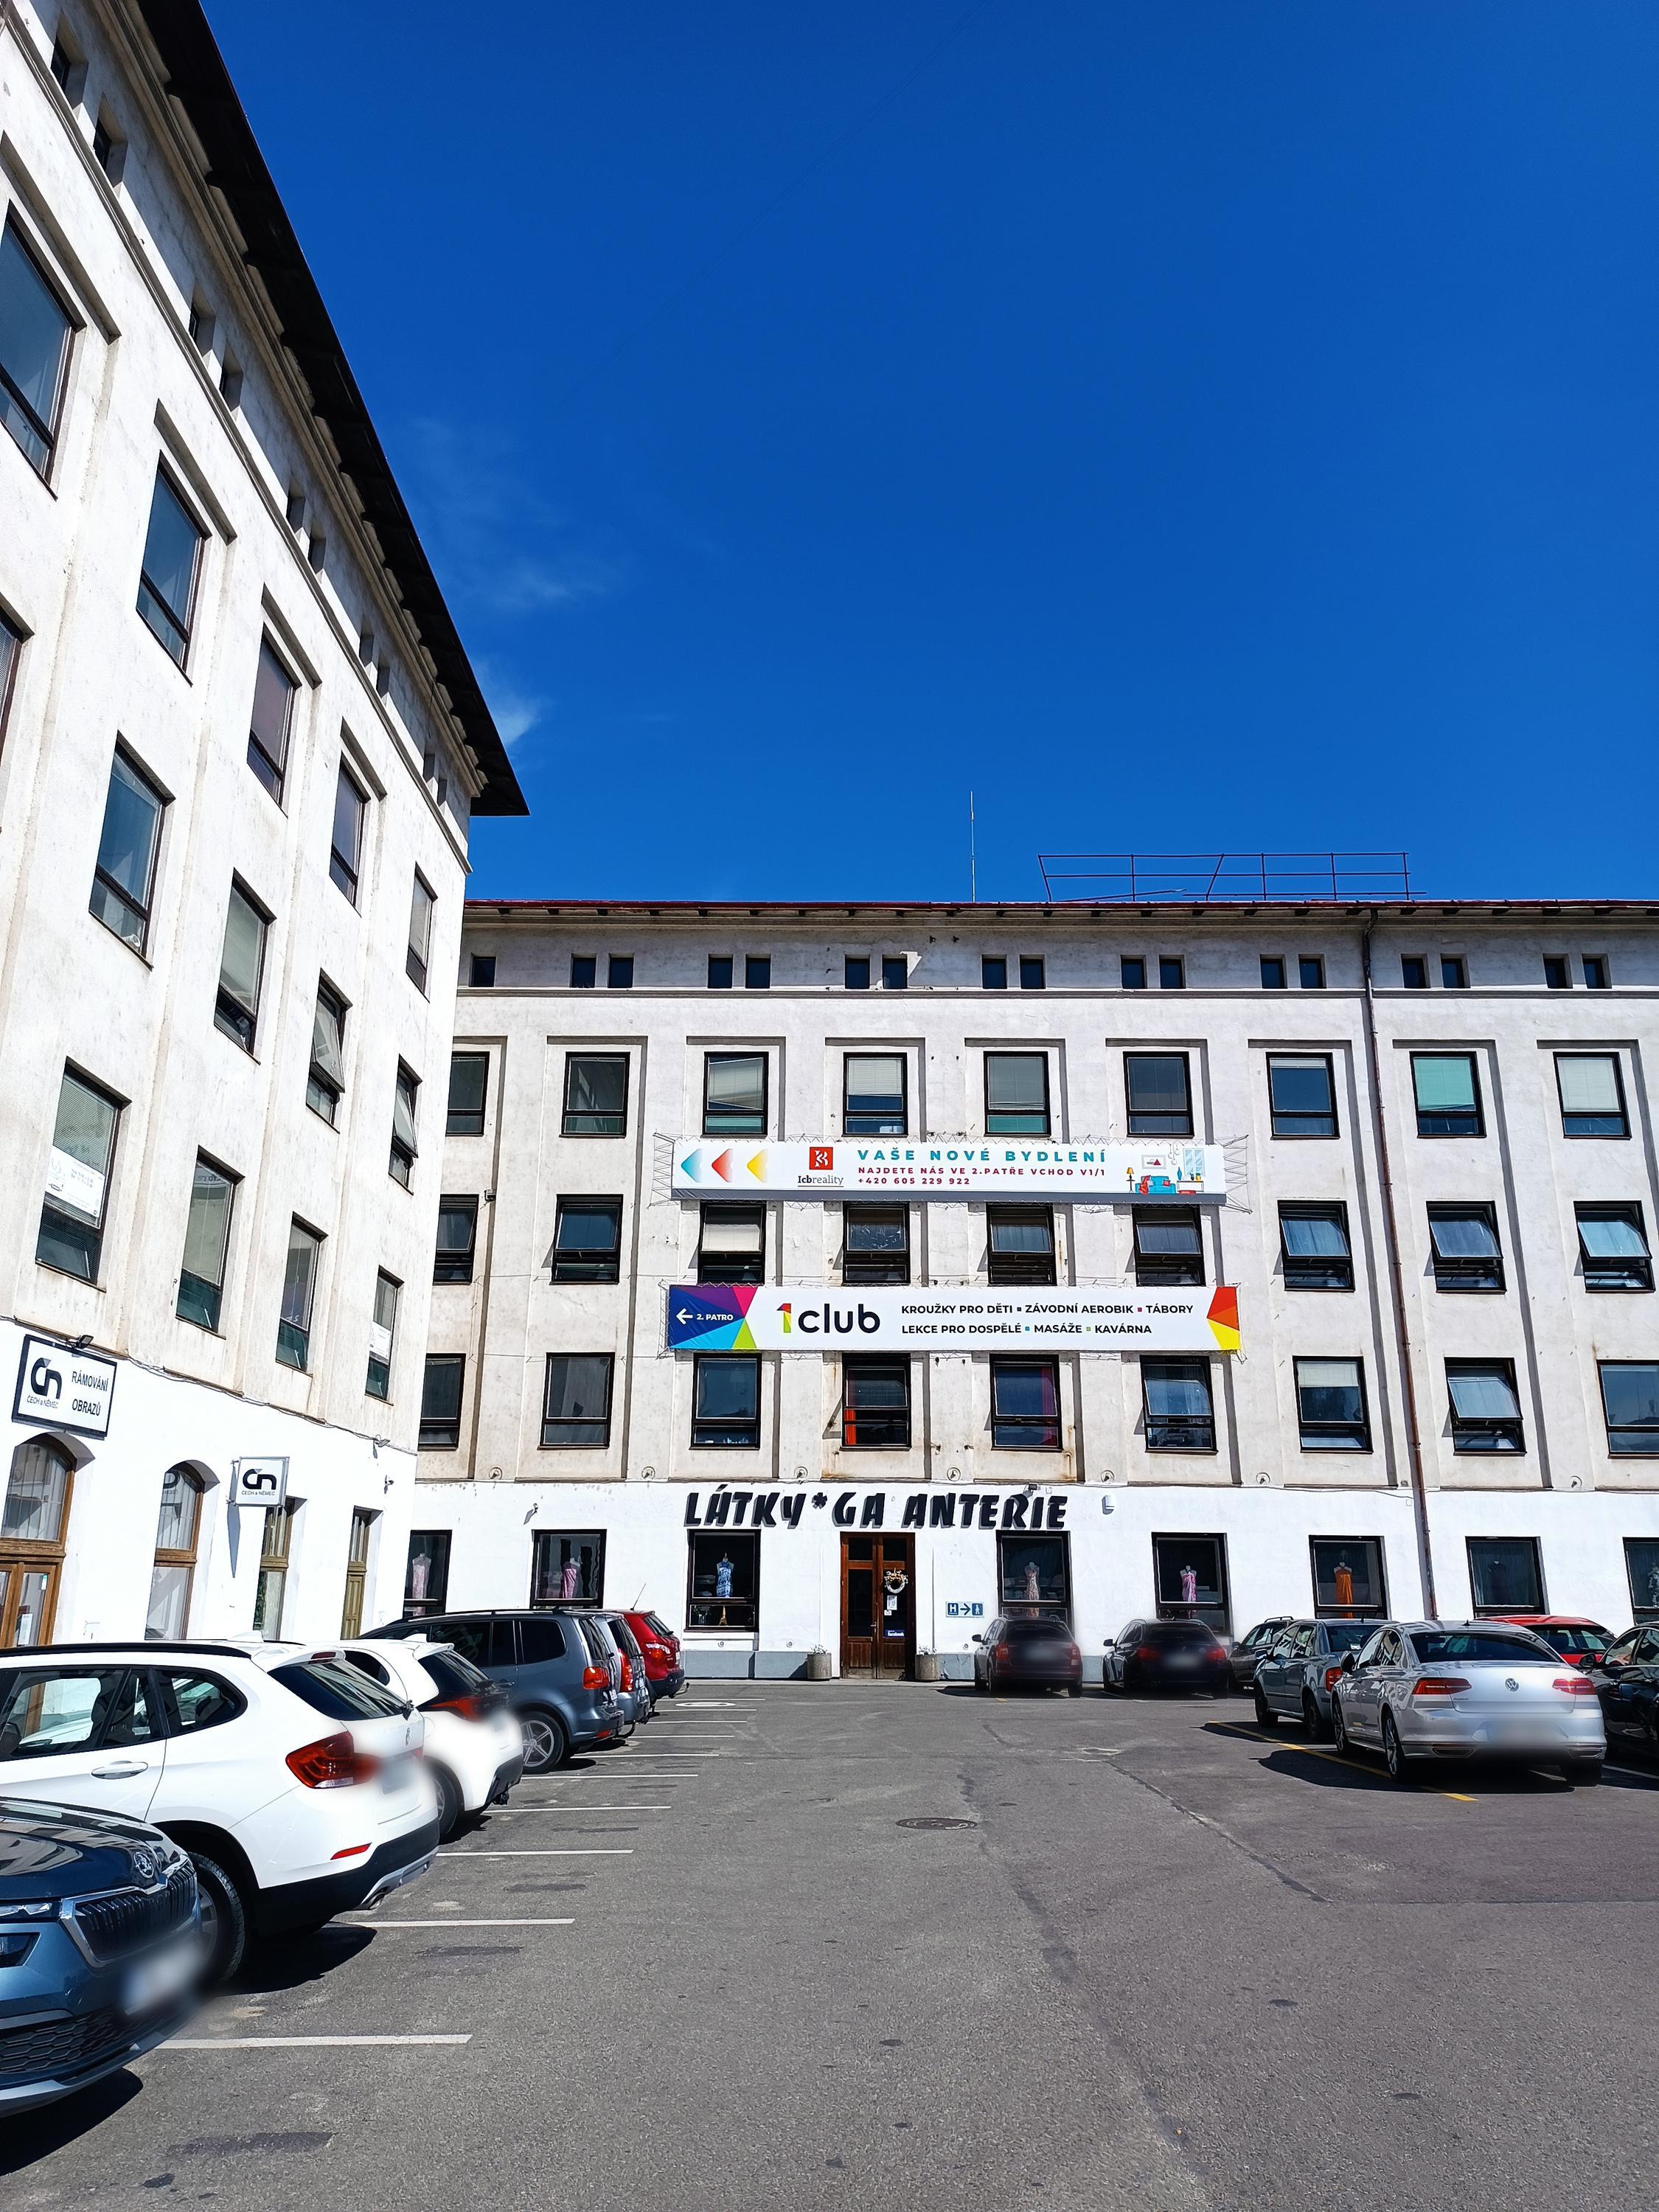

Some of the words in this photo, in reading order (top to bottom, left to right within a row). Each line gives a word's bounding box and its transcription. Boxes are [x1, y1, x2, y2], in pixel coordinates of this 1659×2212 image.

[858, 1147, 915, 1161] VAŠE
[930, 1148, 990, 1161] NOVÉ
[1005, 1149, 1105, 1163] BYDLENÍ
[920, 1166, 945, 1175] NÁS
[1031, 1168, 1074, 1176] VCHOD
[902, 1303, 956, 1314] KROUŽKY
[959, 1305, 984, 1314] PRO
[987, 1303, 1013, 1314] DĚTI
[1025, 1302, 1078, 1313] ZÁVODNÍ
[1082, 1305, 1134, 1314] AEROBIK
[1146, 1303, 1194, 1314] TÁBORY
[706, 1313, 734, 1321] PATRO
[902, 1325, 938, 1334] LEKCE
[941, 1325, 966, 1334] PRO
[969, 1323, 1022, 1334] DOSPĚLÉ
[1034, 1323, 1082, 1334] MASÁŽE
[1095, 1323, 1152, 1334] KAVÁRNA
[72, 1369, 109, 1392] RÁMOVÁNÍ
[72, 1398, 101, 1416] OBRAZŮ
[950, 1604, 957, 1613] H
